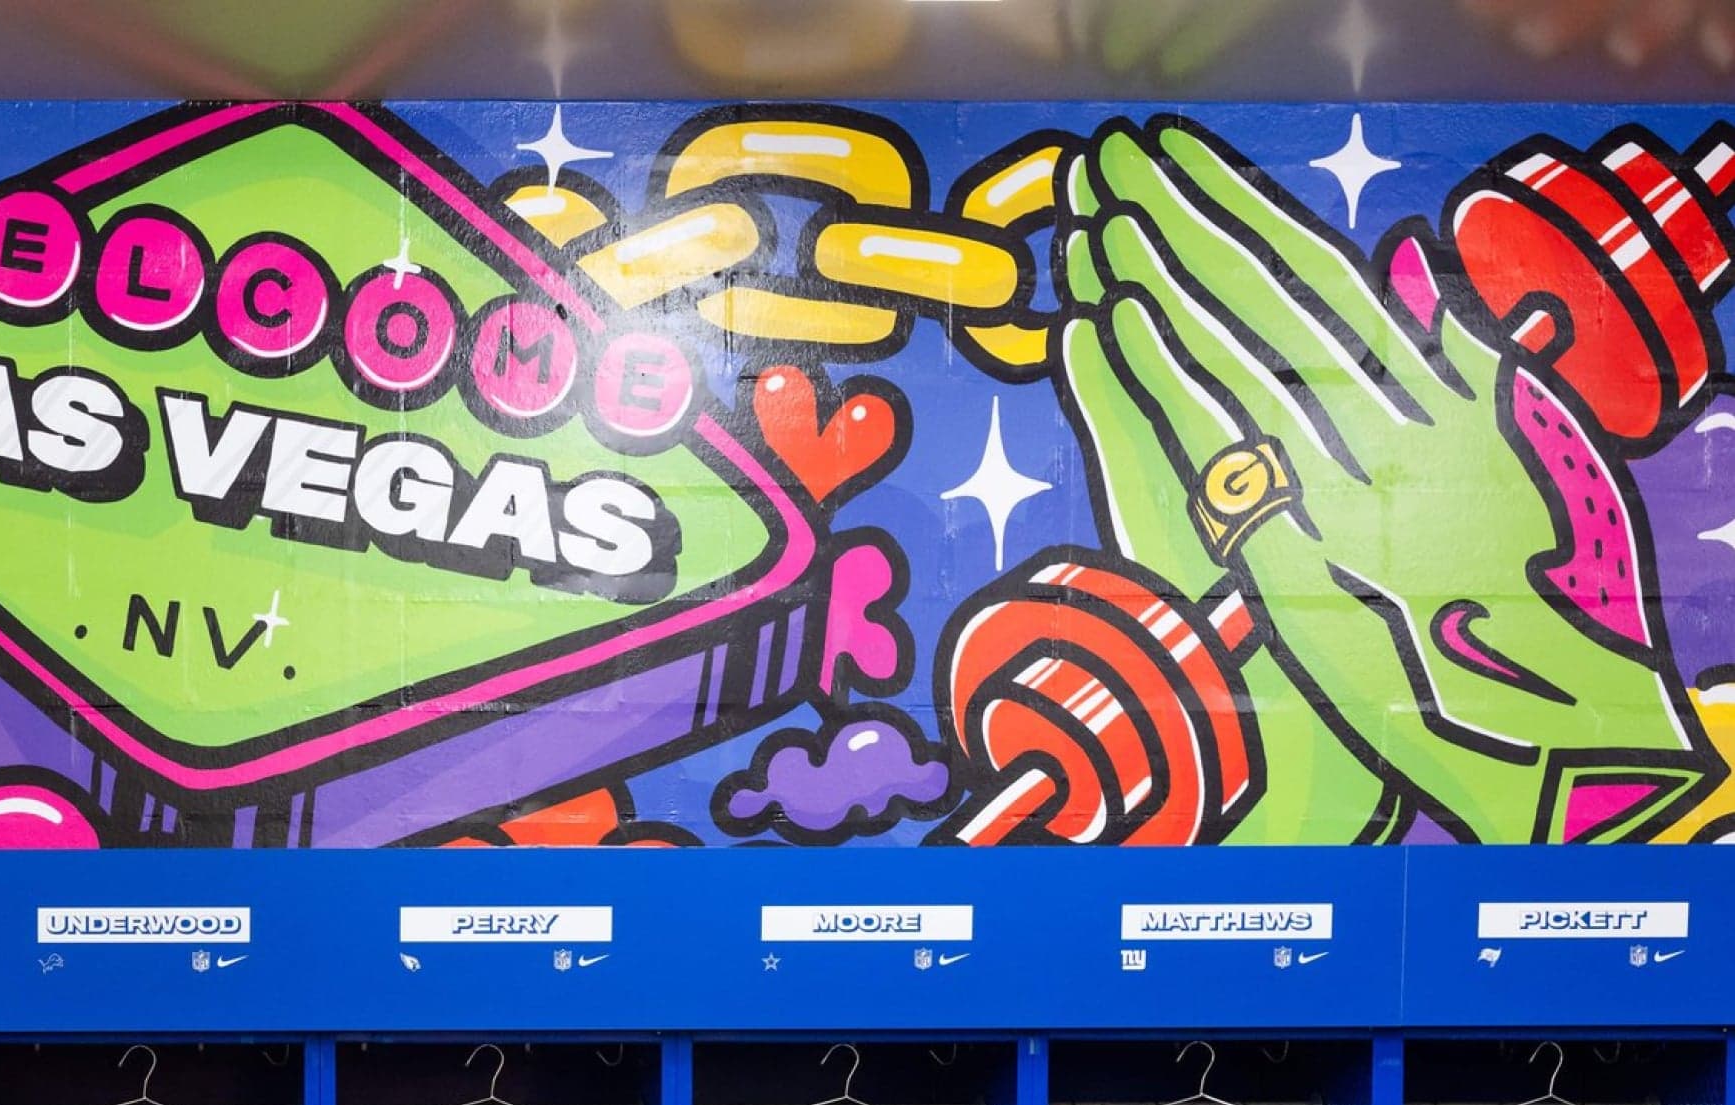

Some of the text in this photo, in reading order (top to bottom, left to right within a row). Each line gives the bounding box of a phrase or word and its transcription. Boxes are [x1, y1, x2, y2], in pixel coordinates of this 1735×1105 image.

[160, 393, 673, 594] VEGAS
[45, 915, 242, 936] UNDERWOOD
[451, 914, 559, 934] PERRY
[812, 912, 923, 933] MOORE
[1140, 911, 1313, 932] MATTHEWS
[1519, 910, 1648, 930] PICKETT
